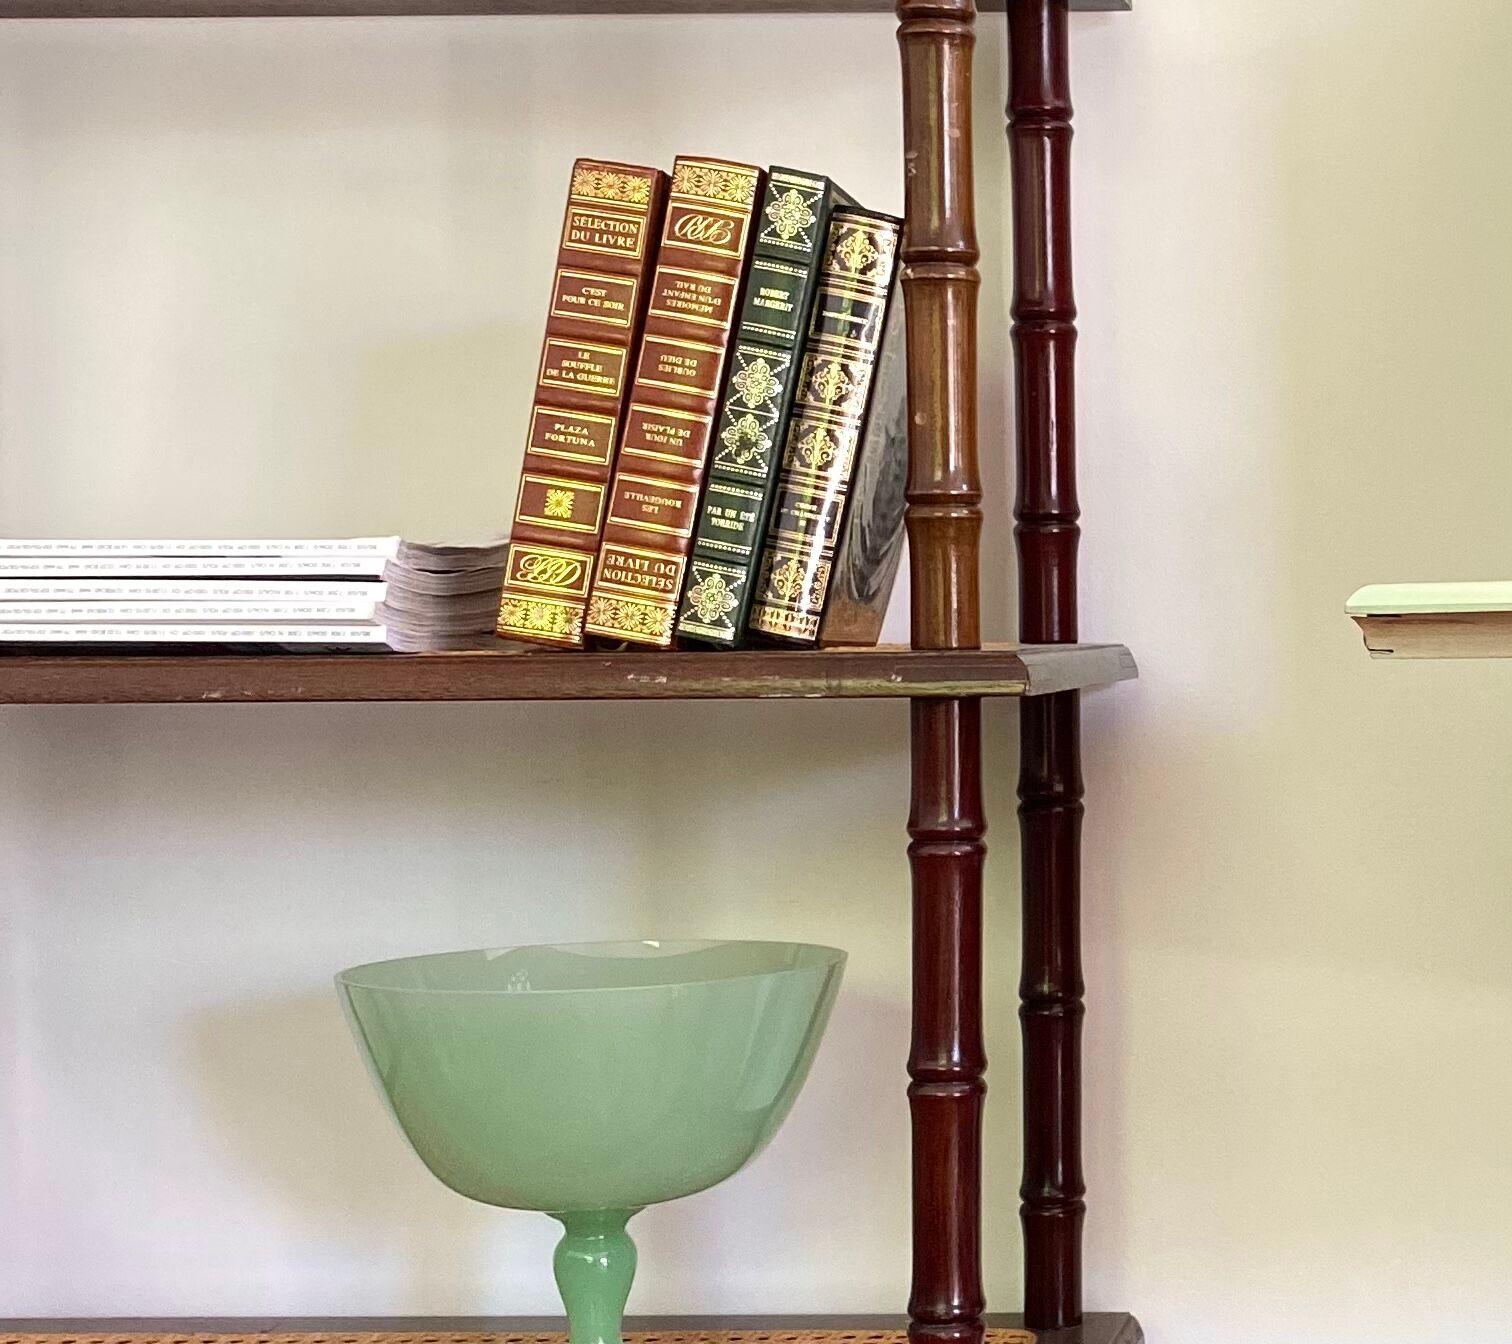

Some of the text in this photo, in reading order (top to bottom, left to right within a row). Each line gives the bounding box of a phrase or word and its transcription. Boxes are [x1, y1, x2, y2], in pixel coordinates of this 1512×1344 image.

[571, 229, 635, 248] DU LIVRE
[674, 280, 712, 294] DU RAIL
[562, 295, 586, 305] POUR
[662, 288, 697, 301] ENFANT
[578, 351, 590, 360] LE
[660, 354, 698, 367] DE DIEU
[561, 360, 603, 373] SOUFFLE
[546, 368, 616, 386] DE LA GUERRE
[554, 423, 589, 435] PLAZA
[641, 422, 691, 439] DE PLAISIR
[545, 432, 595, 448] FORTUNA
[645, 433, 684, 447] UN JOUR
[624, 491, 683, 509] ROUGEVILLE
[641, 504, 659, 515] LES
[706, 505, 722, 516] PAR
[724, 508, 738, 519] UN
[606, 554, 677, 577] DU LIVRE
